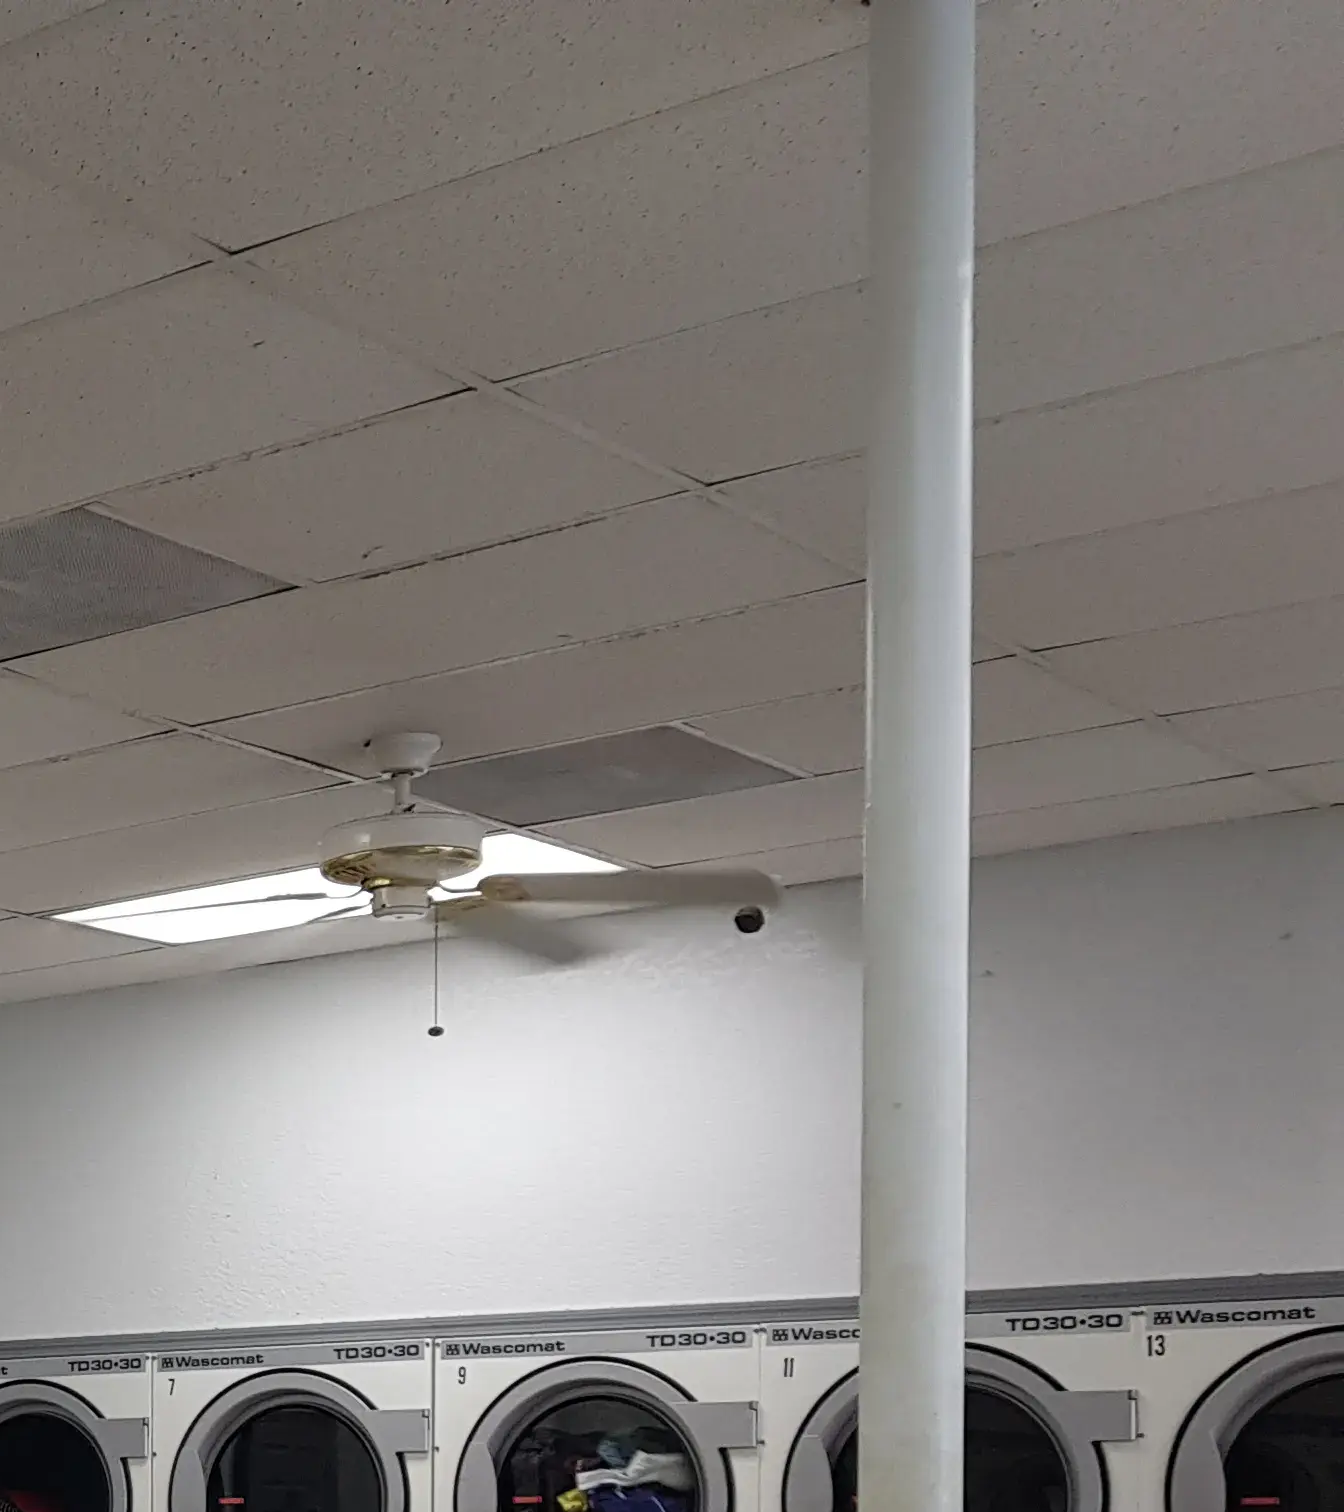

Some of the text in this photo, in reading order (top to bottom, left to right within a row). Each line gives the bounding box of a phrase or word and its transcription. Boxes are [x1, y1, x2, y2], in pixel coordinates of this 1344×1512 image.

[1176, 1305, 1316, 1325] Wascomat
[462, 1339, 565, 1356] Wascomat
[1146, 1334, 1166, 1357] 13
[176, 1352, 264, 1368] Wascomat
[783, 1357, 794, 1378] 11
[458, 1366, 467, 1385] 9
[167, 1378, 176, 1396] 7
